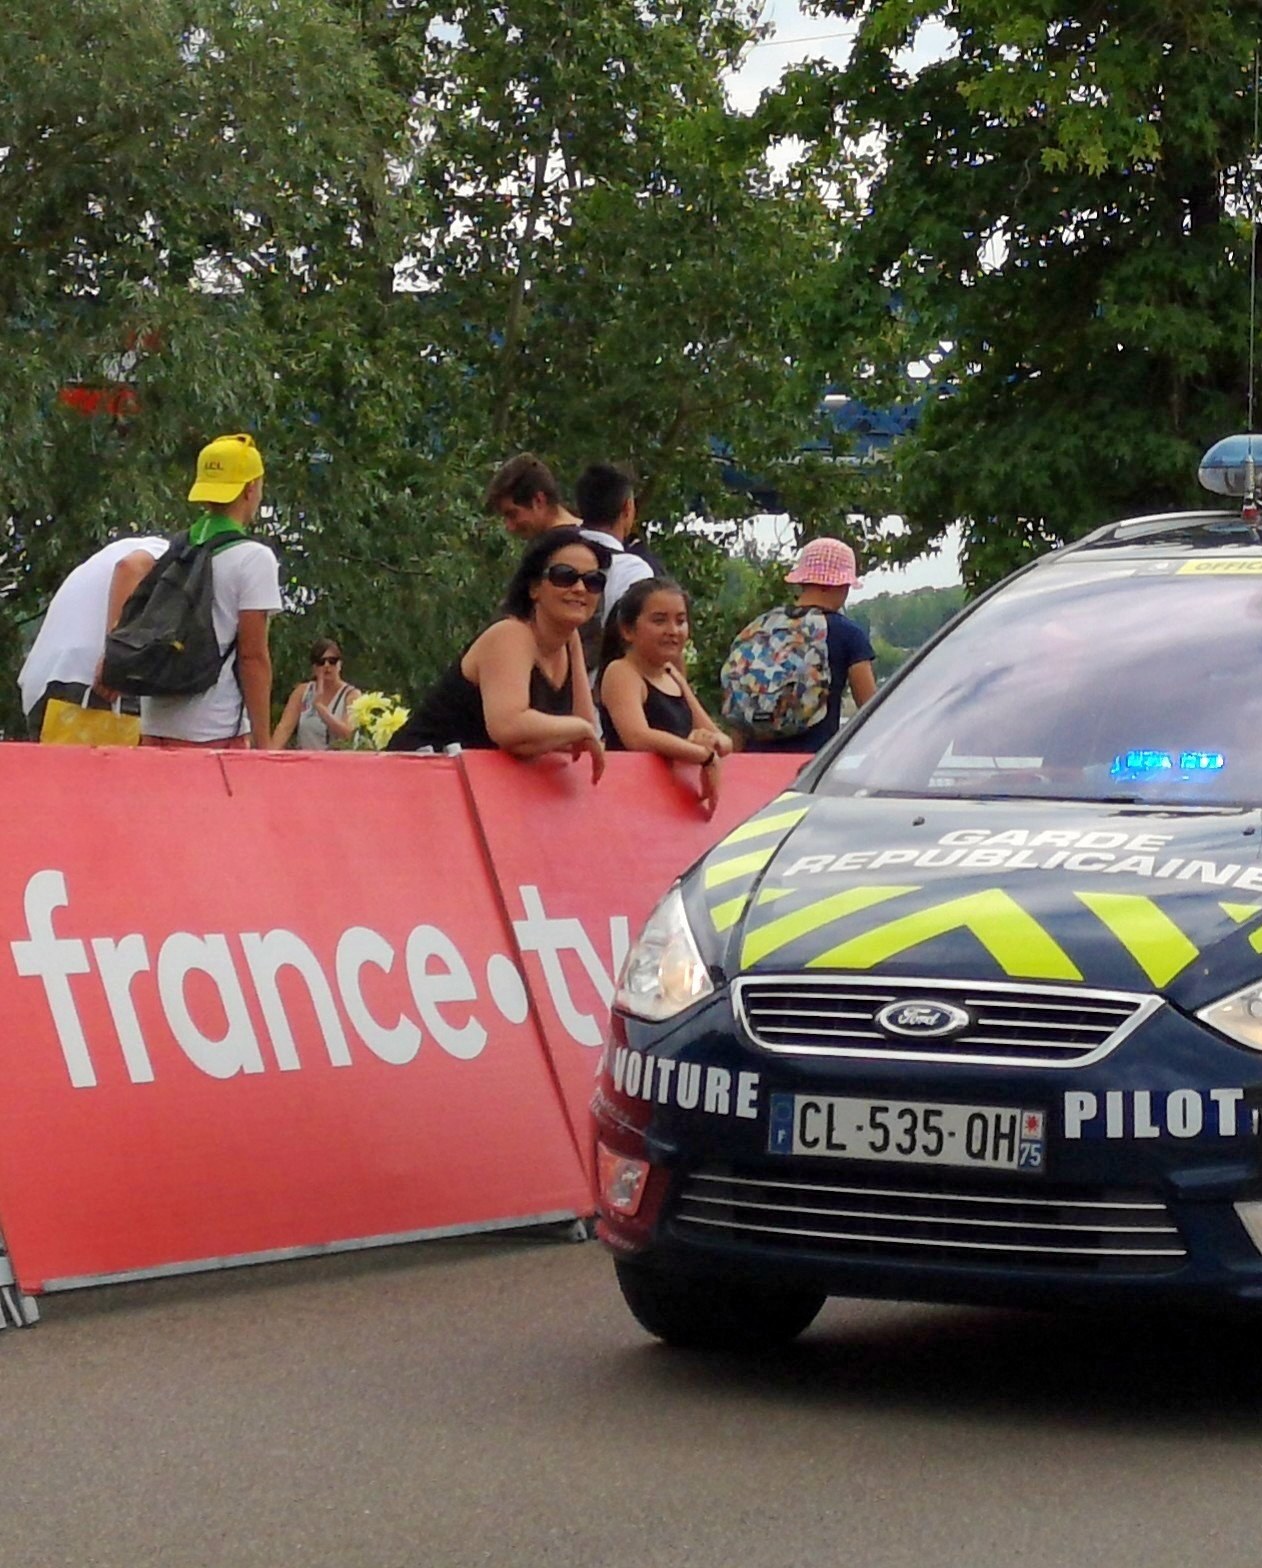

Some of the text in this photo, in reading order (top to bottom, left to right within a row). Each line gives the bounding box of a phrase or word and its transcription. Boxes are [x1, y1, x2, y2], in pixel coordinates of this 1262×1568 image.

[937, 829, 1175, 853] GARDE
[897, 1008, 942, 1026] Ford
[613, 1047, 760, 1120] VOITURE
[1064, 1088, 1259, 1139] PILOT
[1020, 1142, 1042, 1166] 75
